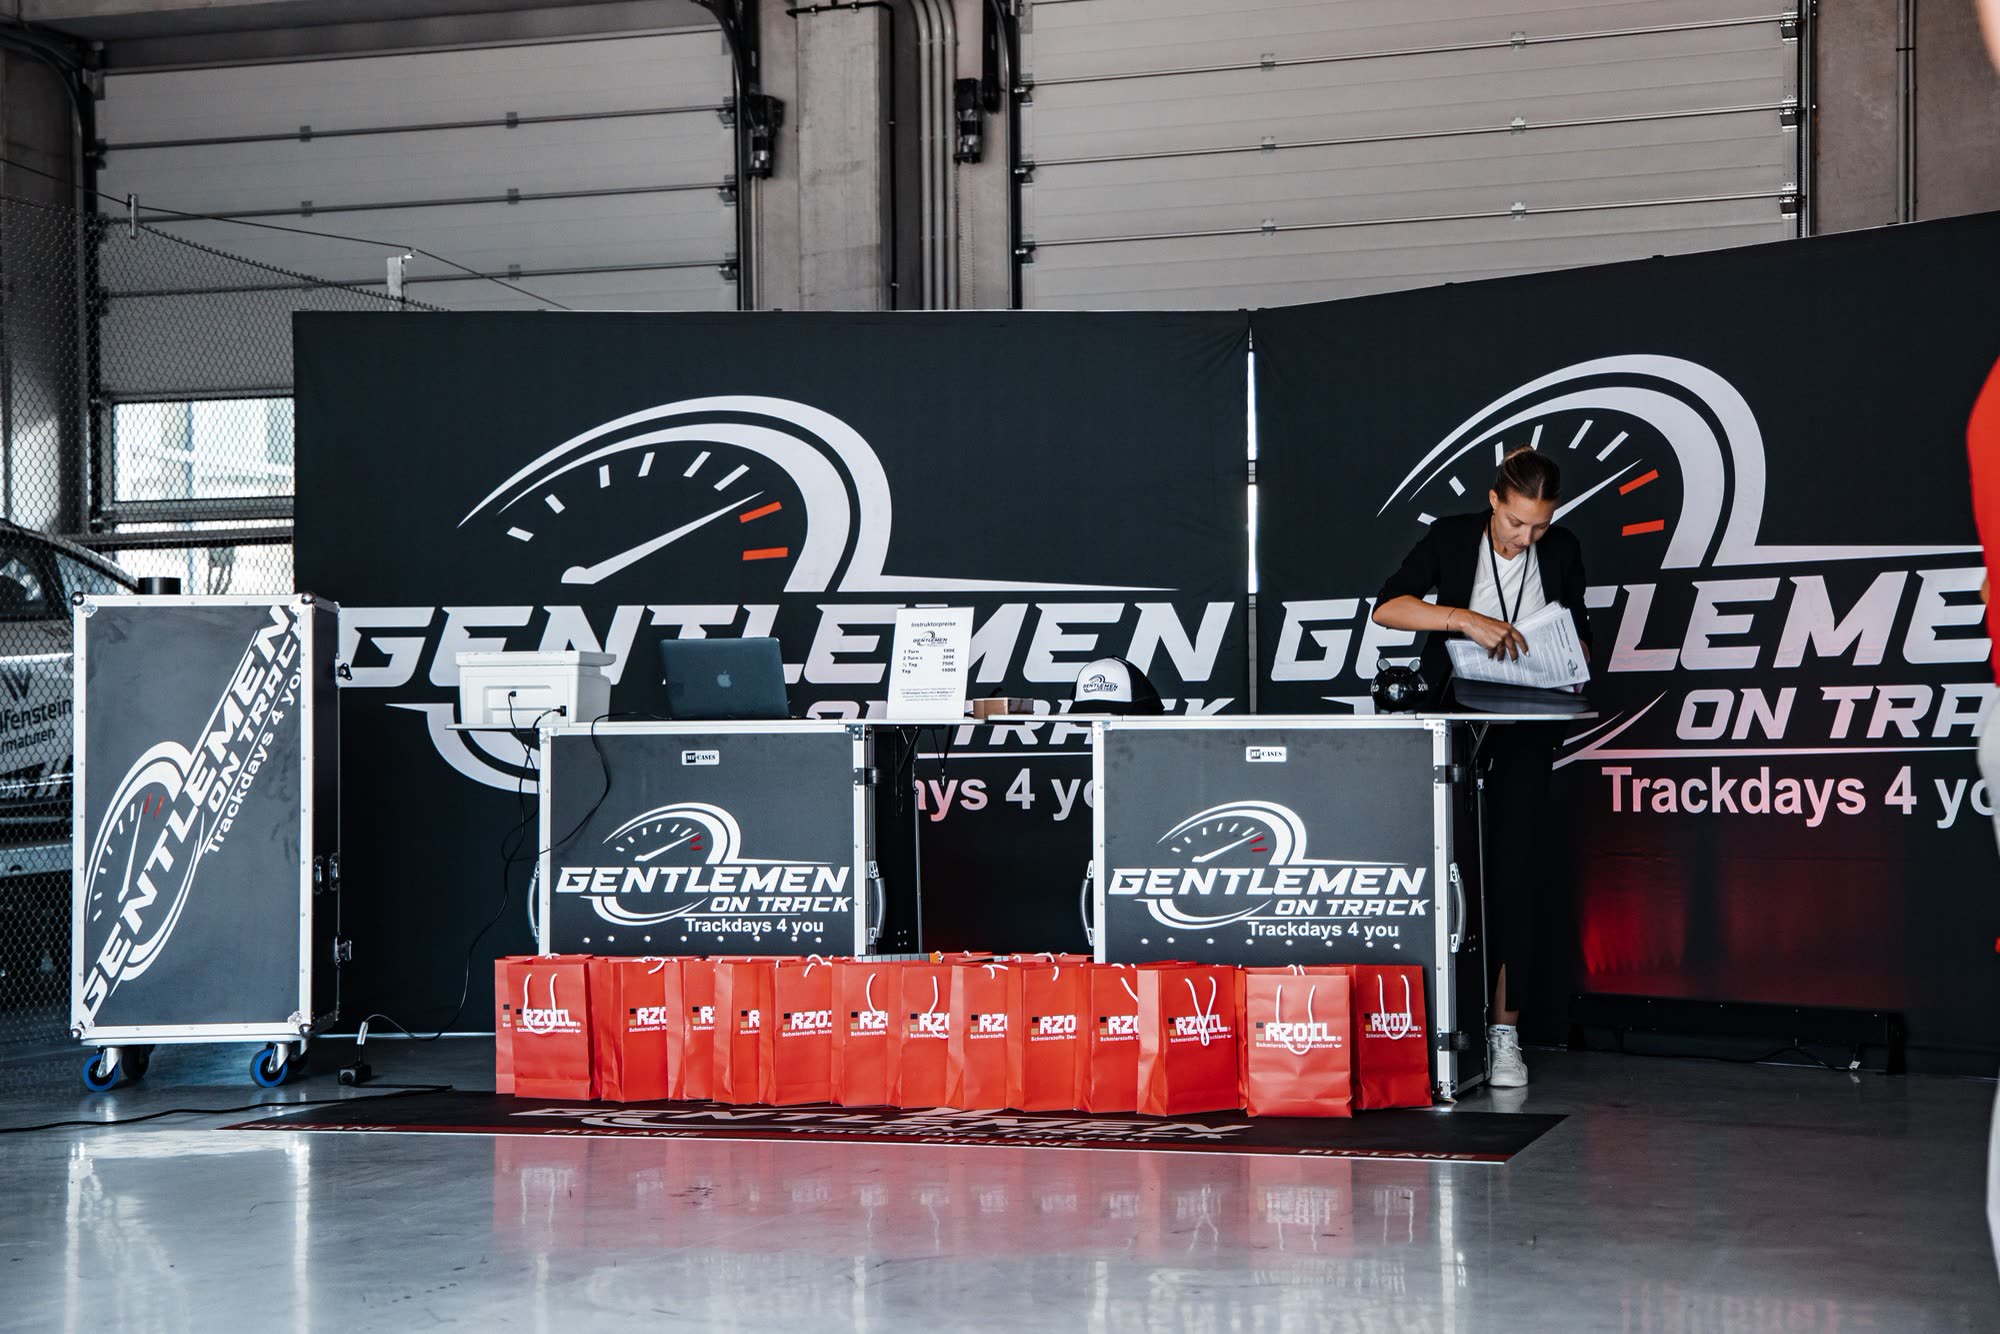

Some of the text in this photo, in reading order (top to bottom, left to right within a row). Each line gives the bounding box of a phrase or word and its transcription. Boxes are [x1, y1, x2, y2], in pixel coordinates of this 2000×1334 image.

[1676, 686, 1802, 741] ON
[204, 731, 274, 854] Trackdays
[271, 709, 284, 726] 4
[208, 751, 241, 813] ON
[1005, 767, 1036, 810] 4
[1602, 765, 1867, 828] Trackdays
[1885, 765, 1918, 815] 4
[82, 605, 290, 1028] GENTLEMEN
[555, 866, 850, 894] GENTLEMEN
[1107, 867, 1427, 896] GENTLEMEN
[710, 896, 853, 913] ON TRACK
[1274, 898, 1431, 917] ON TRACK
[684, 917, 824, 936] Trackdays 4 you
[1247, 921, 1400, 942] Trackdays 4 you
[1265, 1022, 1337, 1042] RZOIL
[509, 1107, 1253, 1134] GENTLEMEN
